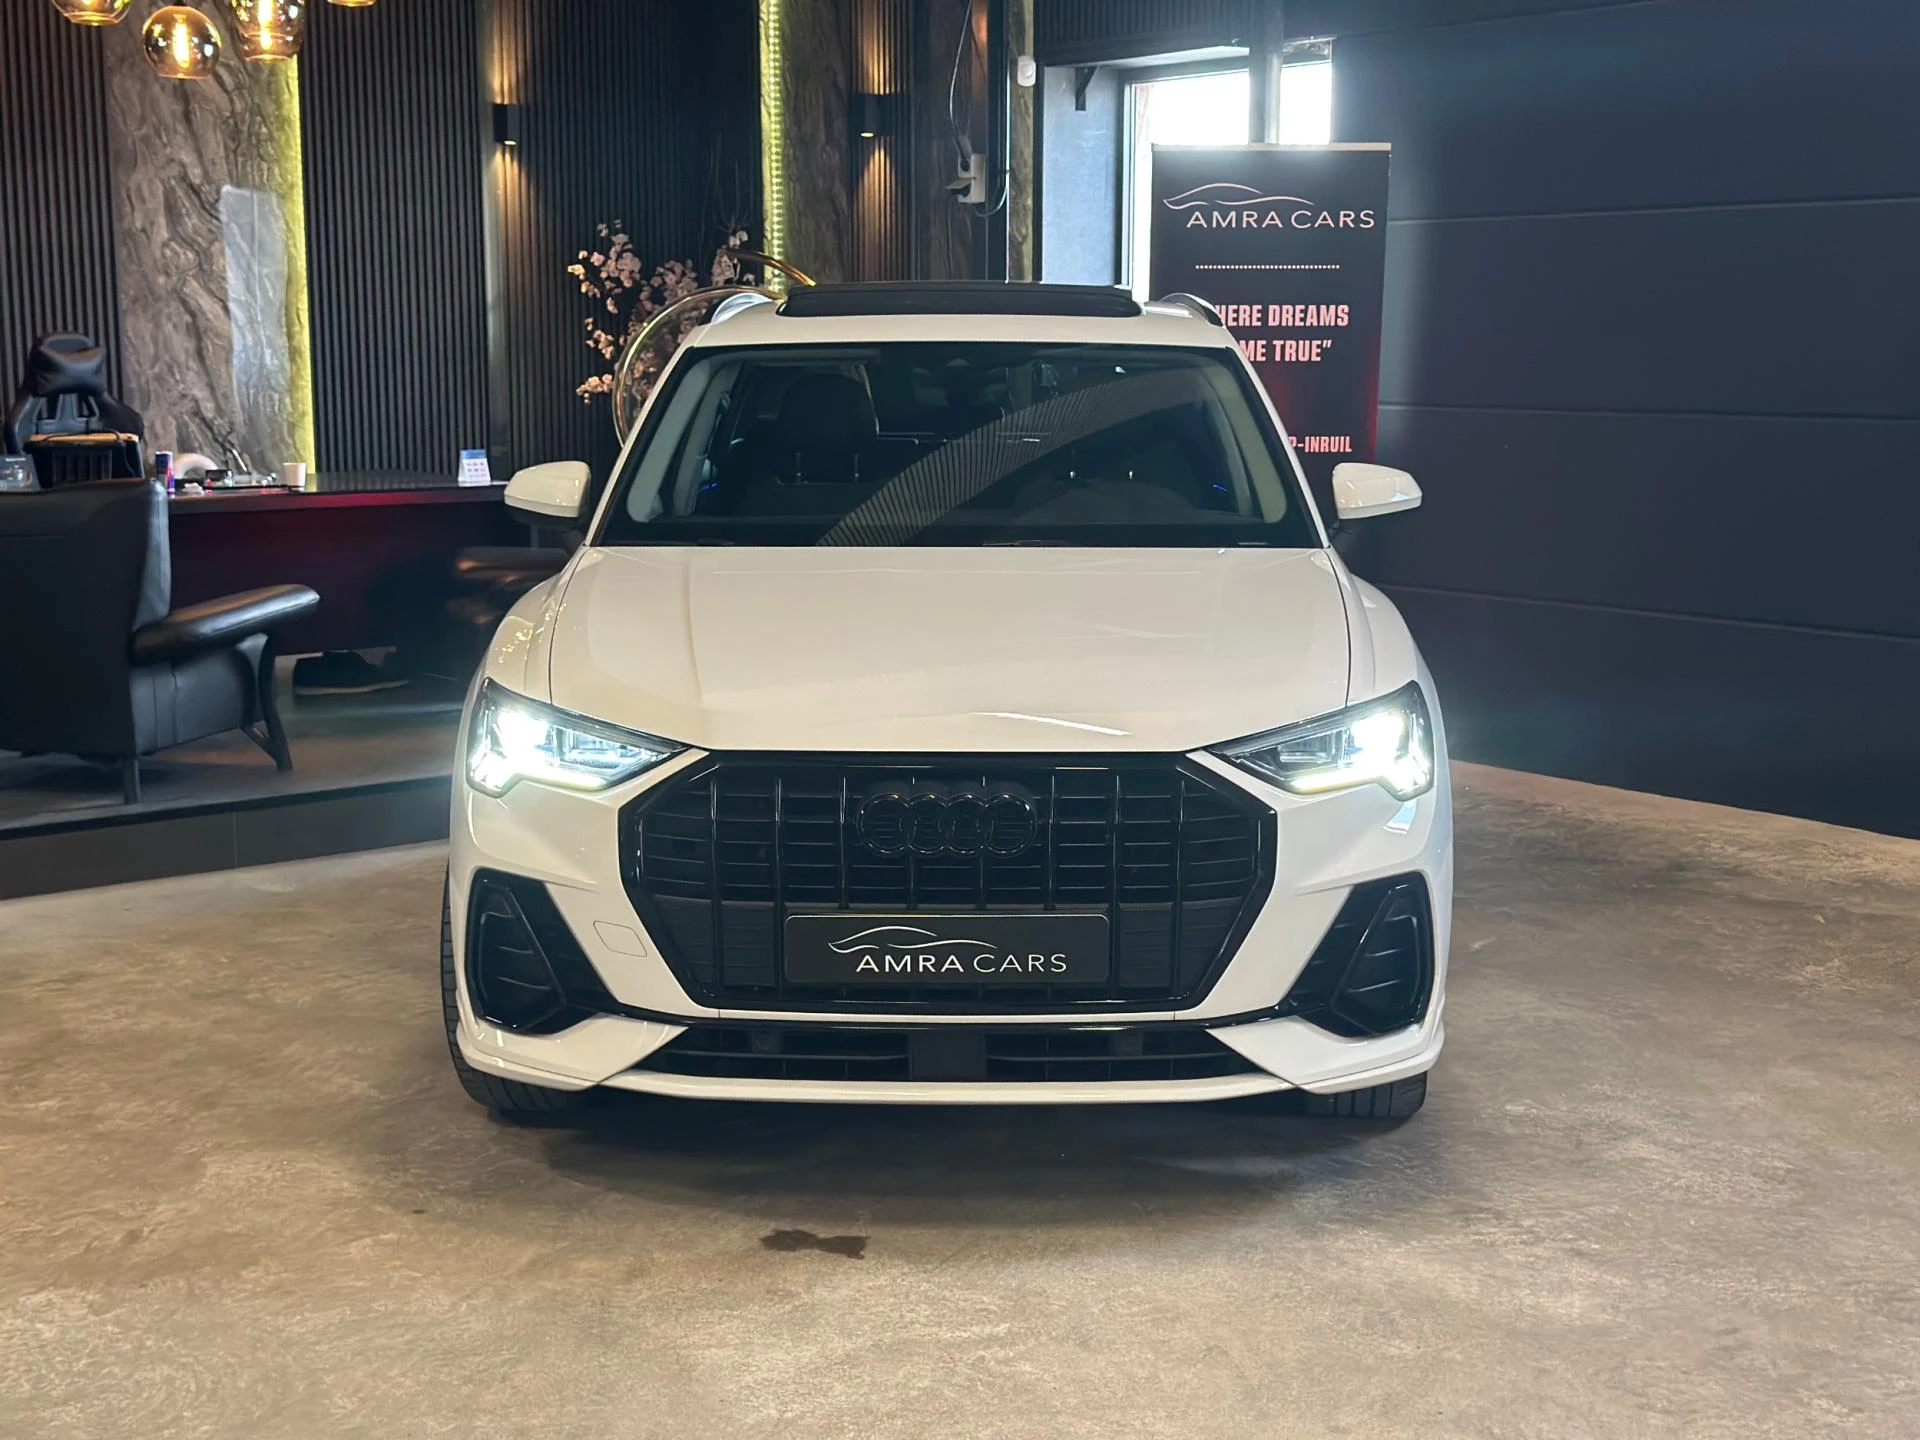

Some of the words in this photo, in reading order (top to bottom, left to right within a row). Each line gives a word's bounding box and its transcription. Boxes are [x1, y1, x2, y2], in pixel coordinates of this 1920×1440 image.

[1186, 210, 1283, 228] AMRA
[1290, 210, 1375, 229] CARS
[1215, 304, 1262, 327] HERE
[1268, 304, 1349, 327] DREAMS
[1240, 340, 1266, 362] ME
[1273, 339, 1332, 362] TRUE"
[1288, 436, 1352, 453] P-INRUIL
[856, 954, 964, 973] AMRA
[973, 954, 1067, 973] CARS
